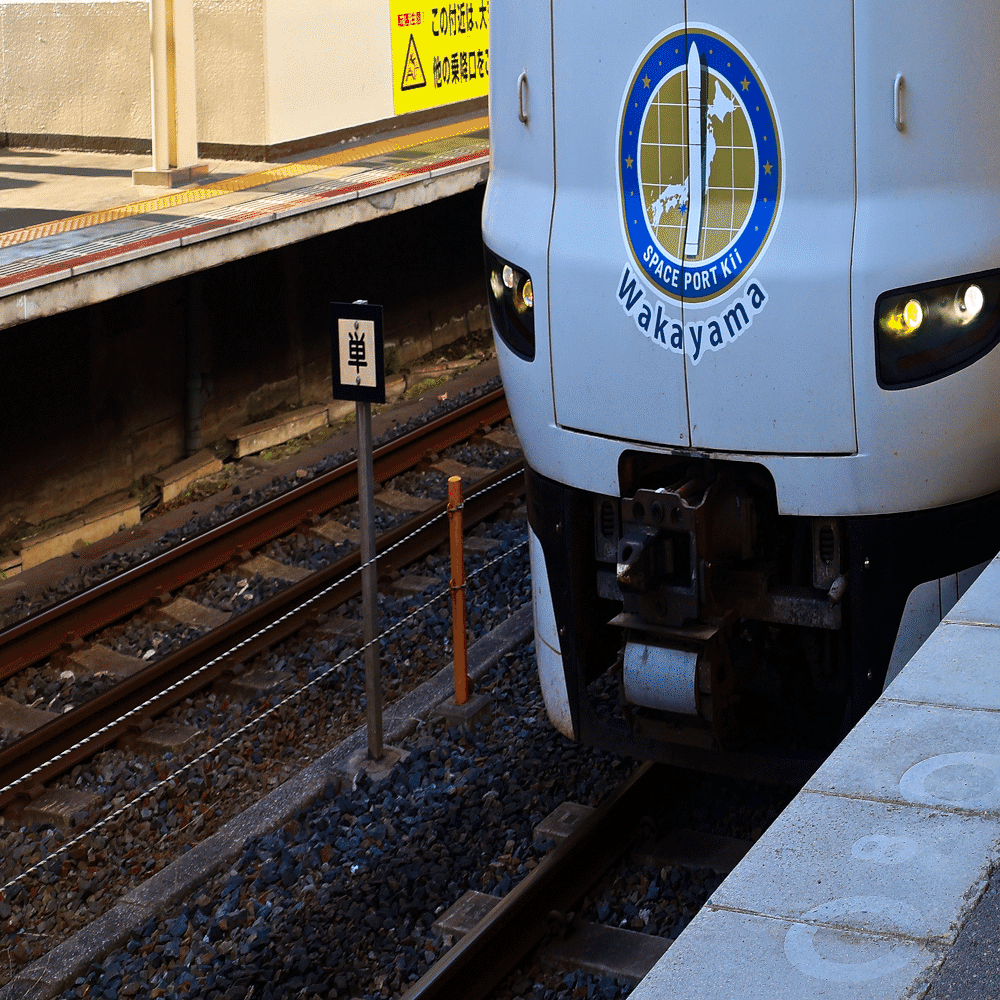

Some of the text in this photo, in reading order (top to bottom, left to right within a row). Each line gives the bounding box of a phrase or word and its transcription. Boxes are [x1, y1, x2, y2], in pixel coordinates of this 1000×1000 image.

[431, 0, 490, 36] この付近は、大
[643, 246, 744, 291] SPACE PORT Kii
[617, 267, 767, 361] Wakayama
[347, 331, 367, 375] 単
